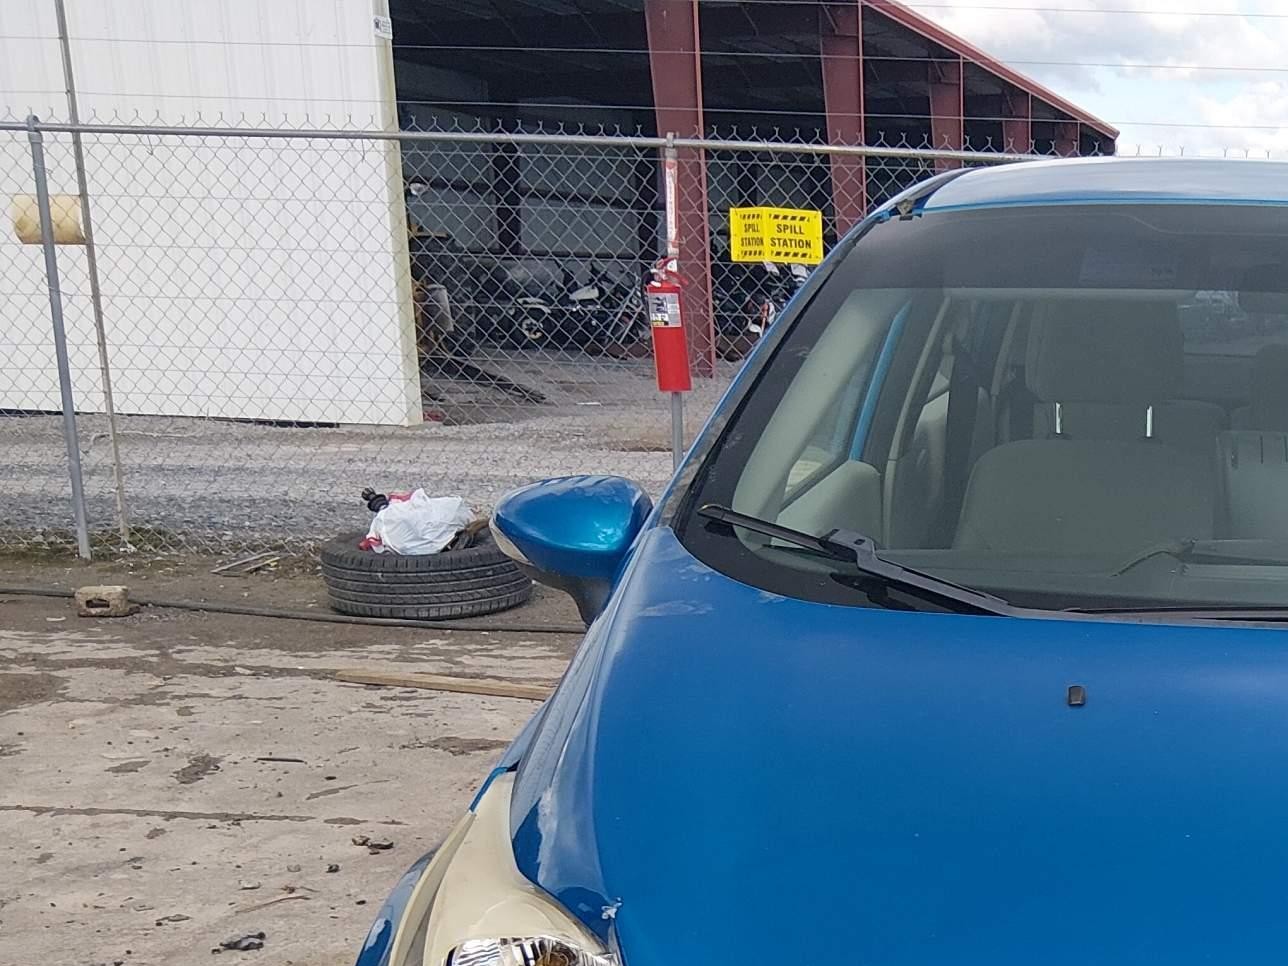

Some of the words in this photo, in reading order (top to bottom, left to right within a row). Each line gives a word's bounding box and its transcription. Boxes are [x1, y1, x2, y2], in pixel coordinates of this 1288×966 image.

[744, 223, 760, 233] SPILL
[776, 224, 805, 235] SPILL
[741, 237, 764, 247] STATION
[770, 238, 812, 249] STATION
